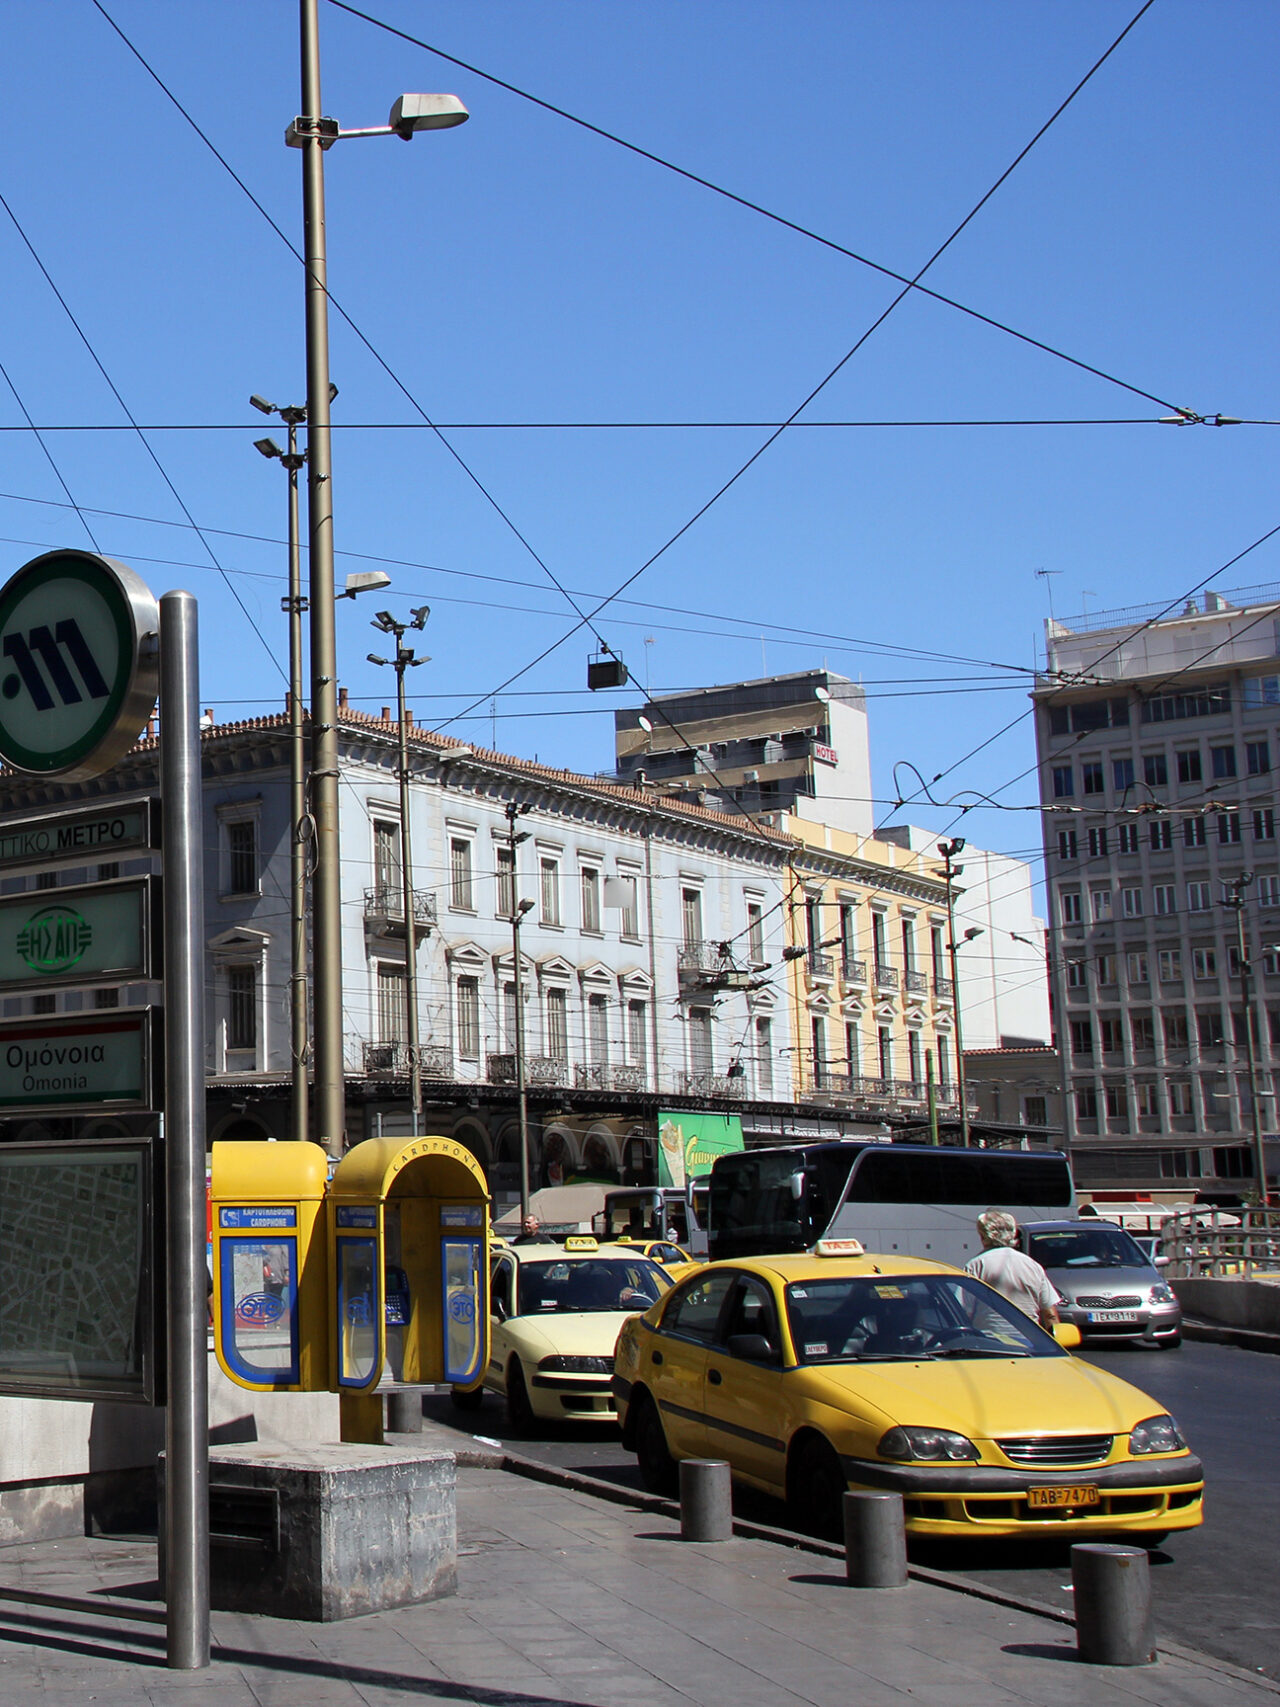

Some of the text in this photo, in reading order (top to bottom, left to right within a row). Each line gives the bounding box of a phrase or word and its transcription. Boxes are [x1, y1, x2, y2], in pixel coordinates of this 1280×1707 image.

[816, 745, 839, 762] HOTEL
[57, 818, 126, 849] ΜΕΤΡΟ
[6, 1042, 105, 1073] Ομόνοια
[22, 1072, 88, 1092] Omonia
[393, 1143, 477, 1172] CARDPHONE
